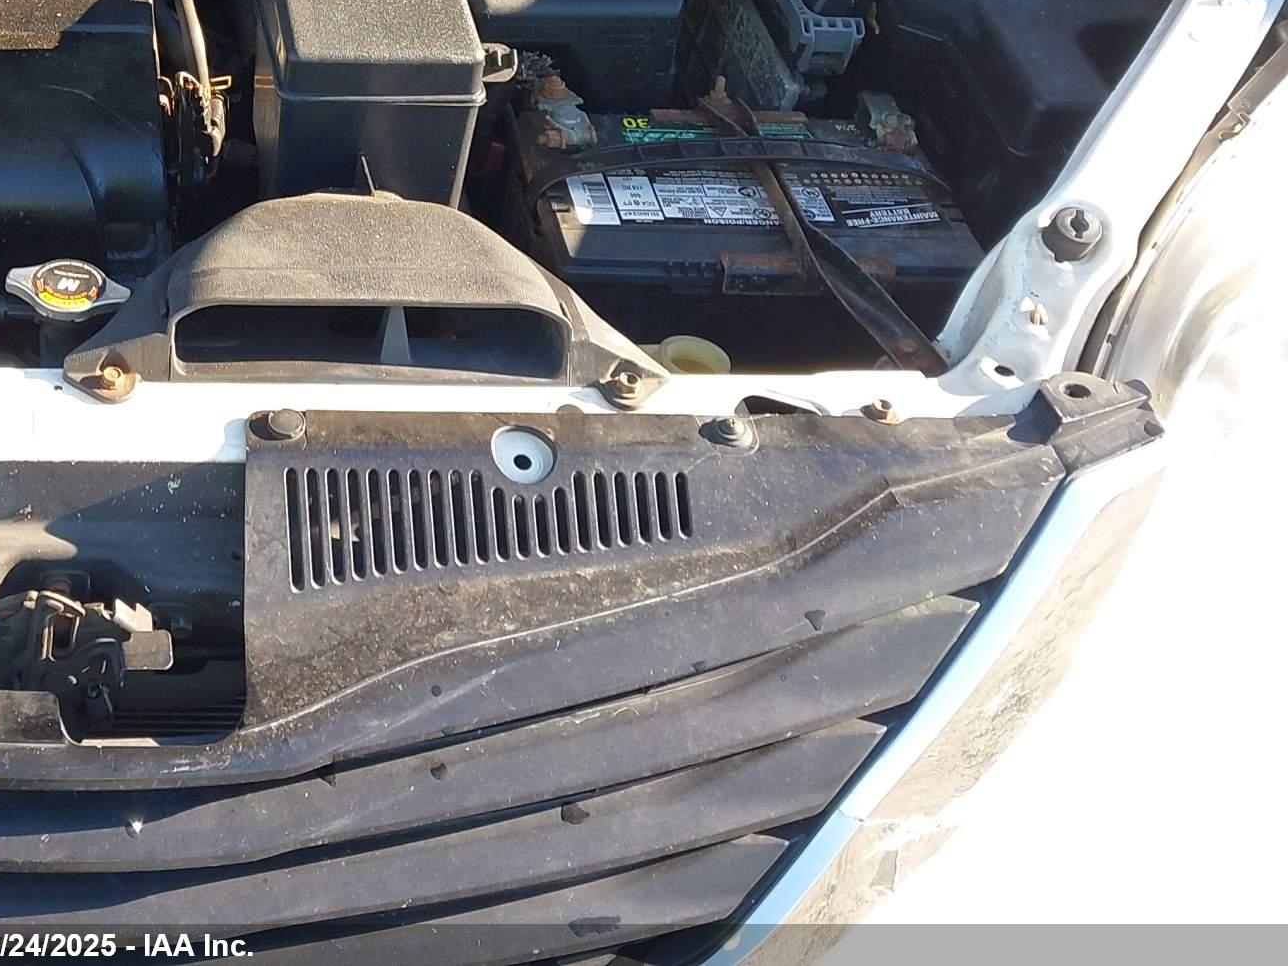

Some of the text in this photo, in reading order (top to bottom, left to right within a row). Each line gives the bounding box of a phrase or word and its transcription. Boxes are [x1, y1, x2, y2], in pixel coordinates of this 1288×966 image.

[868, 207, 910, 218] BATTERY
[703, 218, 782, 226] ANGER/POISON
[845, 210, 939, 227] MAINTENANCE-FREE
